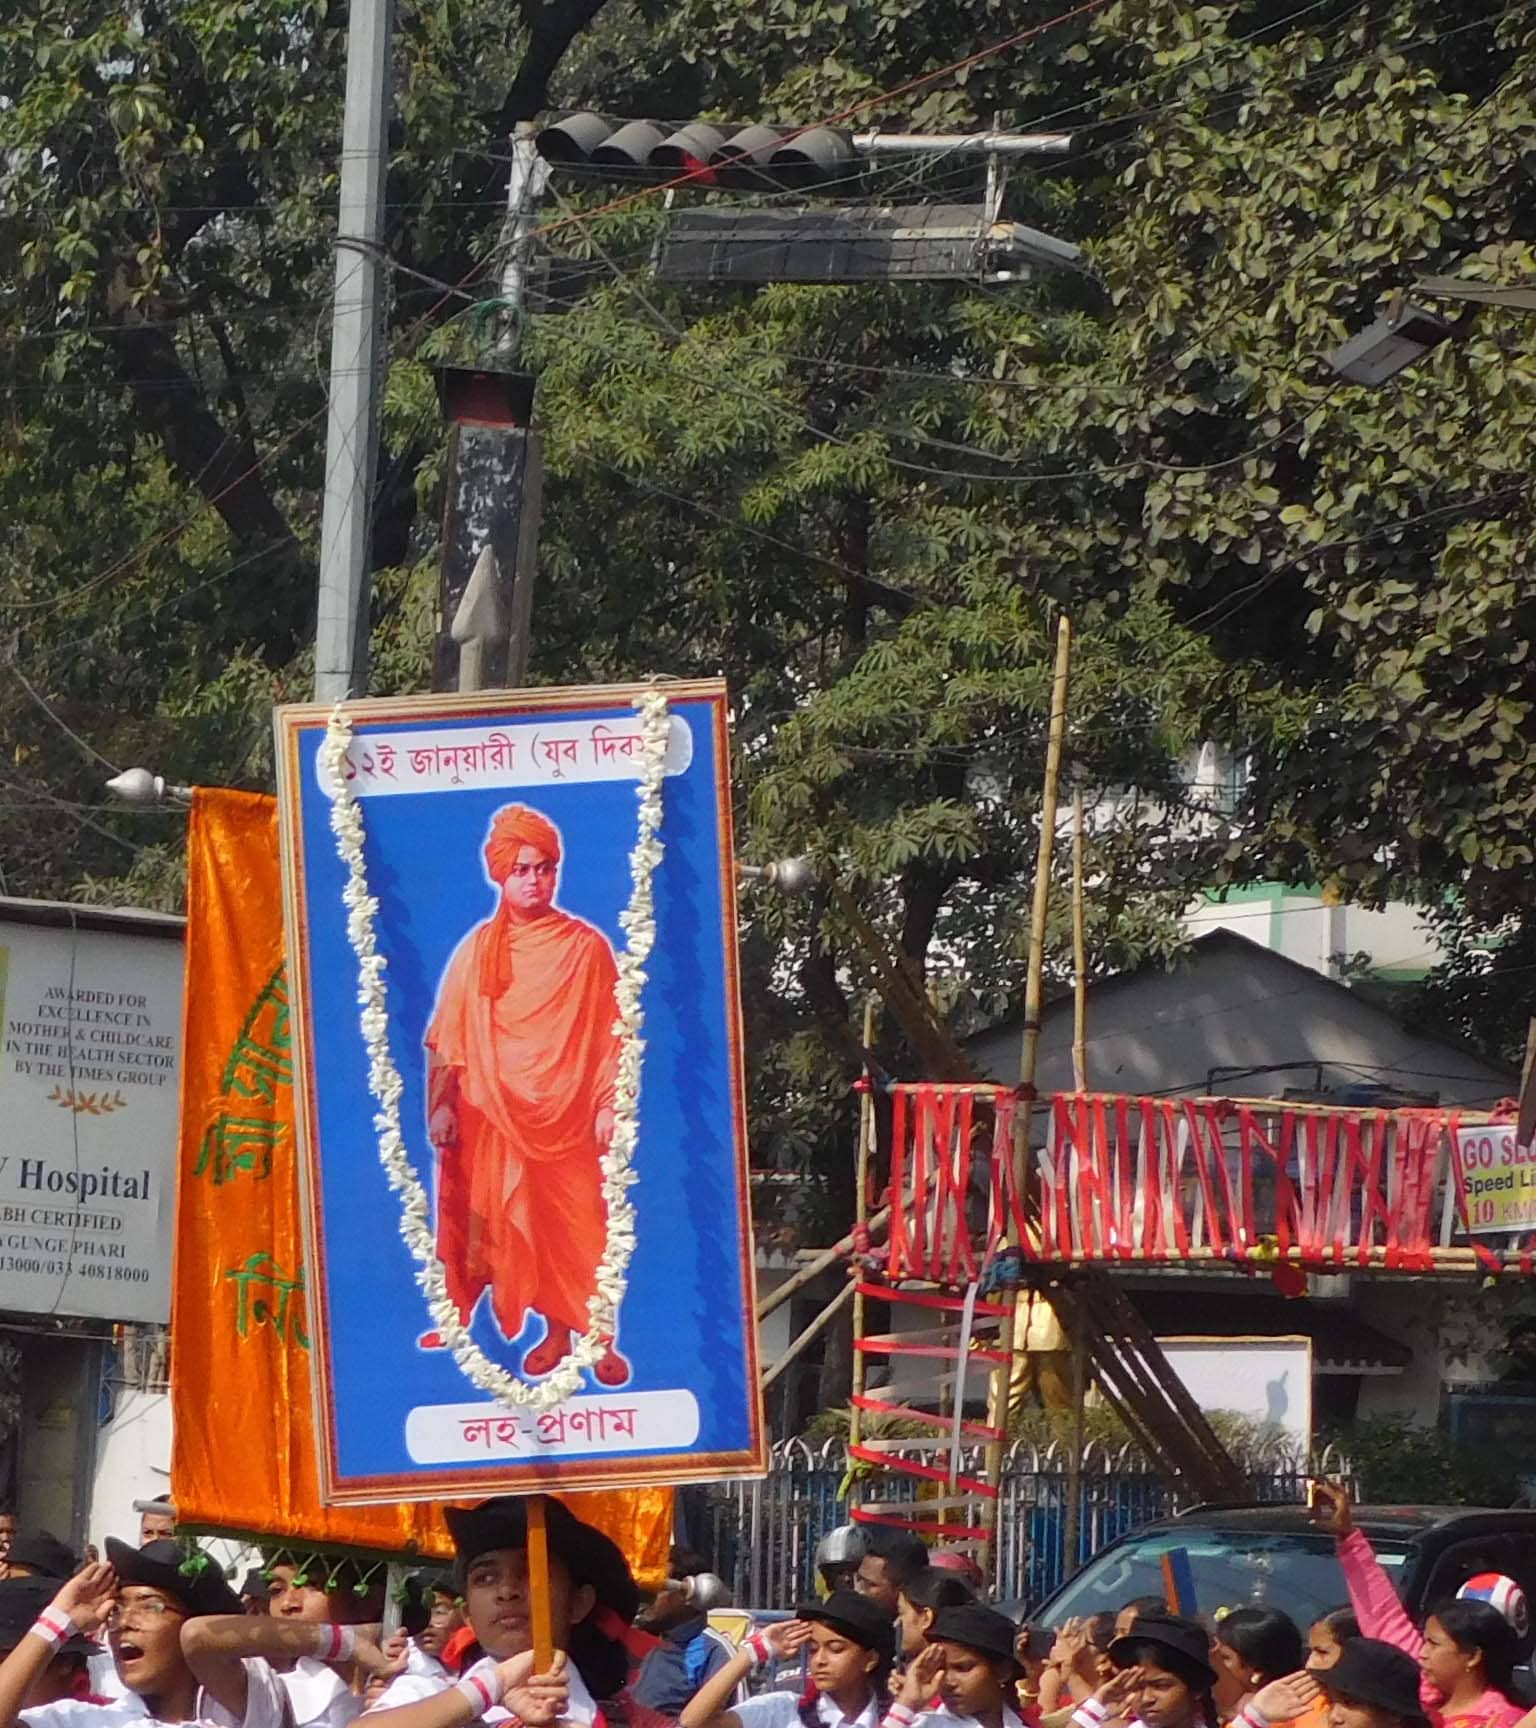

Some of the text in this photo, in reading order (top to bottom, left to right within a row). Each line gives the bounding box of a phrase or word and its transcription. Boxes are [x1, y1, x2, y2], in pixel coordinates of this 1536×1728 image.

[407, 732, 516, 785] জানুয়ারী
[531, 730, 580, 779] (যুব
[592, 724, 646, 766] দিব
[45, 986, 147, 1008] AWARDED FOR
[38, 1005, 151, 1027] EXCELLENCE IN
[8, 1021, 174, 1049] MOTHER & CHILDCARE
[6, 1040, 175, 1069] IN THE HEALTH SECTOR
[15, 1060, 167, 1087] BY THE TIMES GROUP
[1464, 1137, 1493, 1169] GO
[17, 1159, 150, 1202] Hospital
[1464, 1171, 1514, 1197] Speed
[30, 1209, 121, 1231] CERTIFIED
[1473, 1199, 1494, 1225] 10
[72, 1242, 126, 1259] PHARI
[79, 1264, 150, 1283] 40818000
